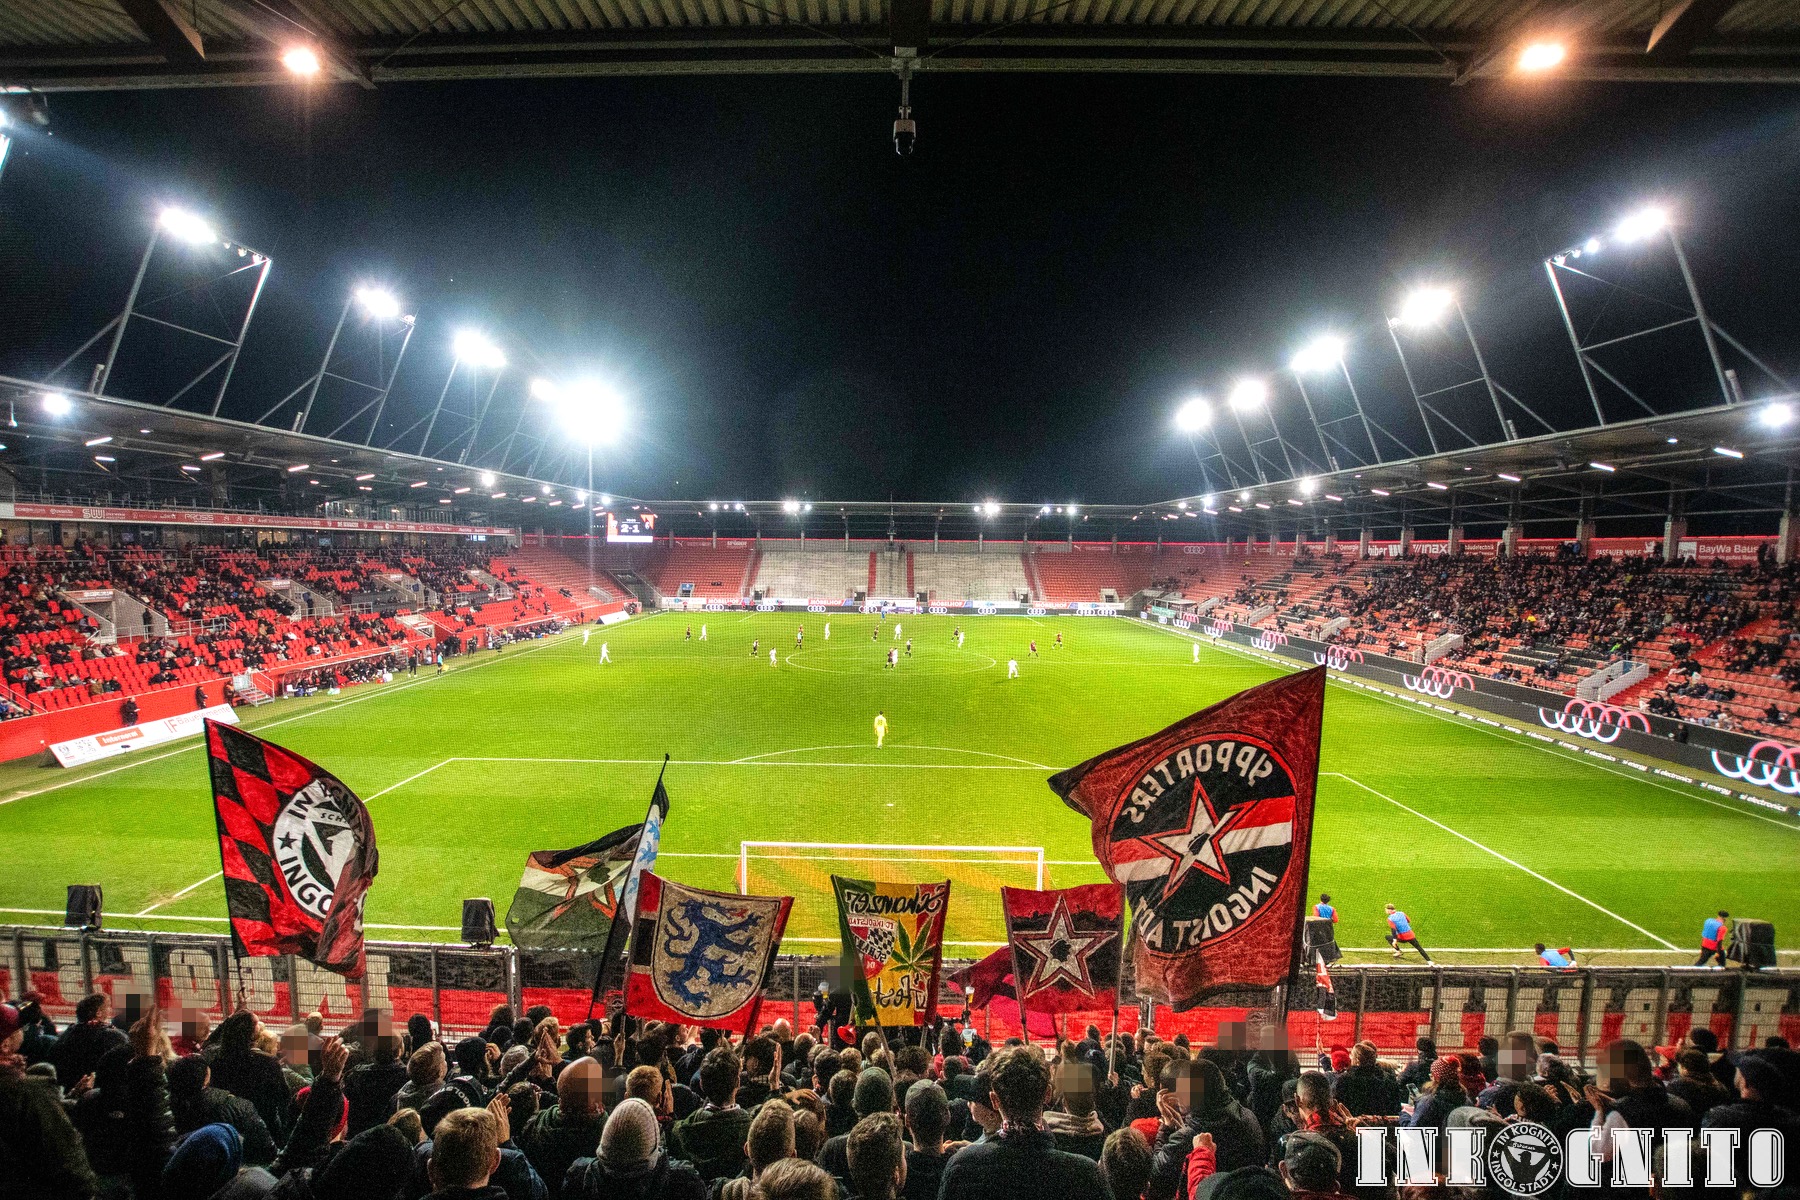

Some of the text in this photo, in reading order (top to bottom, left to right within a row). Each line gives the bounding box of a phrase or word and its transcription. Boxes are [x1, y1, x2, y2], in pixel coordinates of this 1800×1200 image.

[620, 523, 640, 534] 2-1
[1699, 544, 1731, 555] BayWa
[177, 705, 231, 727] Bauelemente
[102, 731, 139, 745] Internorm
[287, 792, 313, 820] IN
